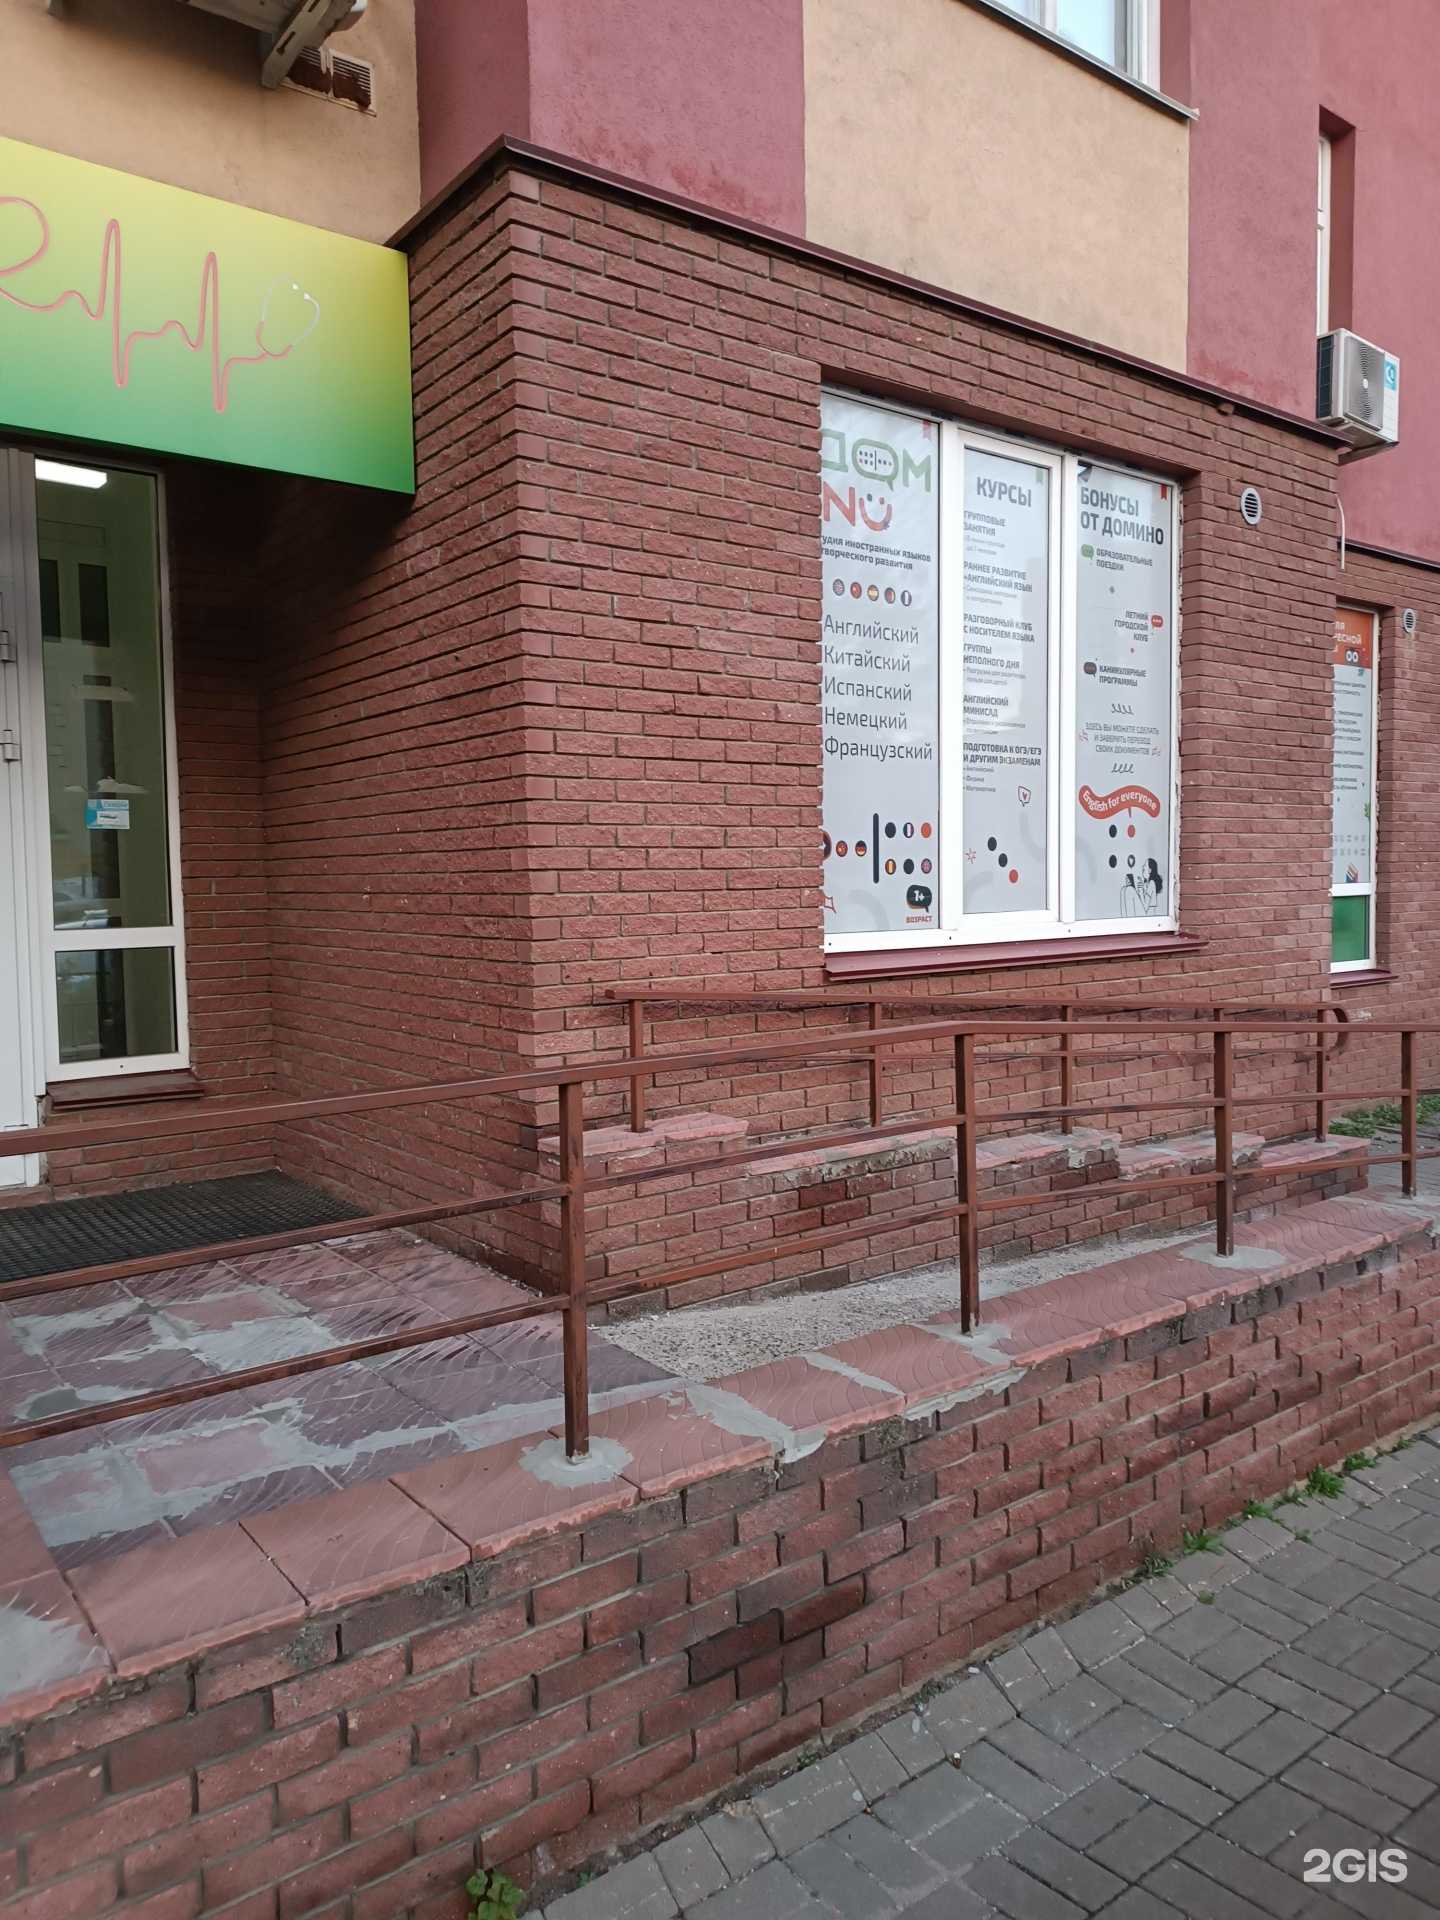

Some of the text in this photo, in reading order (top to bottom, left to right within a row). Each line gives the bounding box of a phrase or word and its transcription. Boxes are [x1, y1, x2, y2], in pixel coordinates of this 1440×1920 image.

[976, 476, 1032, 508] КУРСЫ
[1080, 486, 1139, 517] БОНУСЫ
[1080, 510, 1164, 545] ОТ ДОМИНО
[844, 539, 901, 556] иностранных
[902, 551, 932, 562] языков
[875, 557, 913, 570] развития
[963, 560, 1027, 581] РАННЕЕ РАЗВИТИЕ
[1013, 581, 1033, 593] ЯЗЫК
[963, 613, 1014, 628] РАЗГОВОРНЫЙ
[823, 614, 920, 645] Английский
[969, 625, 1012, 639] НОСИТЕЛЕМ
[1013, 632, 1035, 642] ЯЗЫКА
[963, 643, 992, 655] ГРУППЫ
[823, 645, 911, 673] Китайский
[963, 654, 1021, 670] НЕПОЛНОГО ДНЯ
[824, 675, 912, 702] Испанский
[1099, 675, 1138, 687] ПРОГРАММЫ
[962, 694, 1009, 707] АНГЛИЙСКИЙ
[824, 706, 908, 731] Немецкий
[962, 705, 998, 718] МИНИСАД
[824, 735, 933, 762] Французский
[962, 742, 1009, 754] ПОДГОТОВКА
[1015, 745, 1043, 756] ОГЭ/ЕГЭ
[969, 755, 999, 764] ДРУГИМ
[999, 756, 1041, 767] ЭКЗАМЕНАМ
[1082, 790, 1157, 811] English for everyone
[913, 889, 925, 902] 1+
